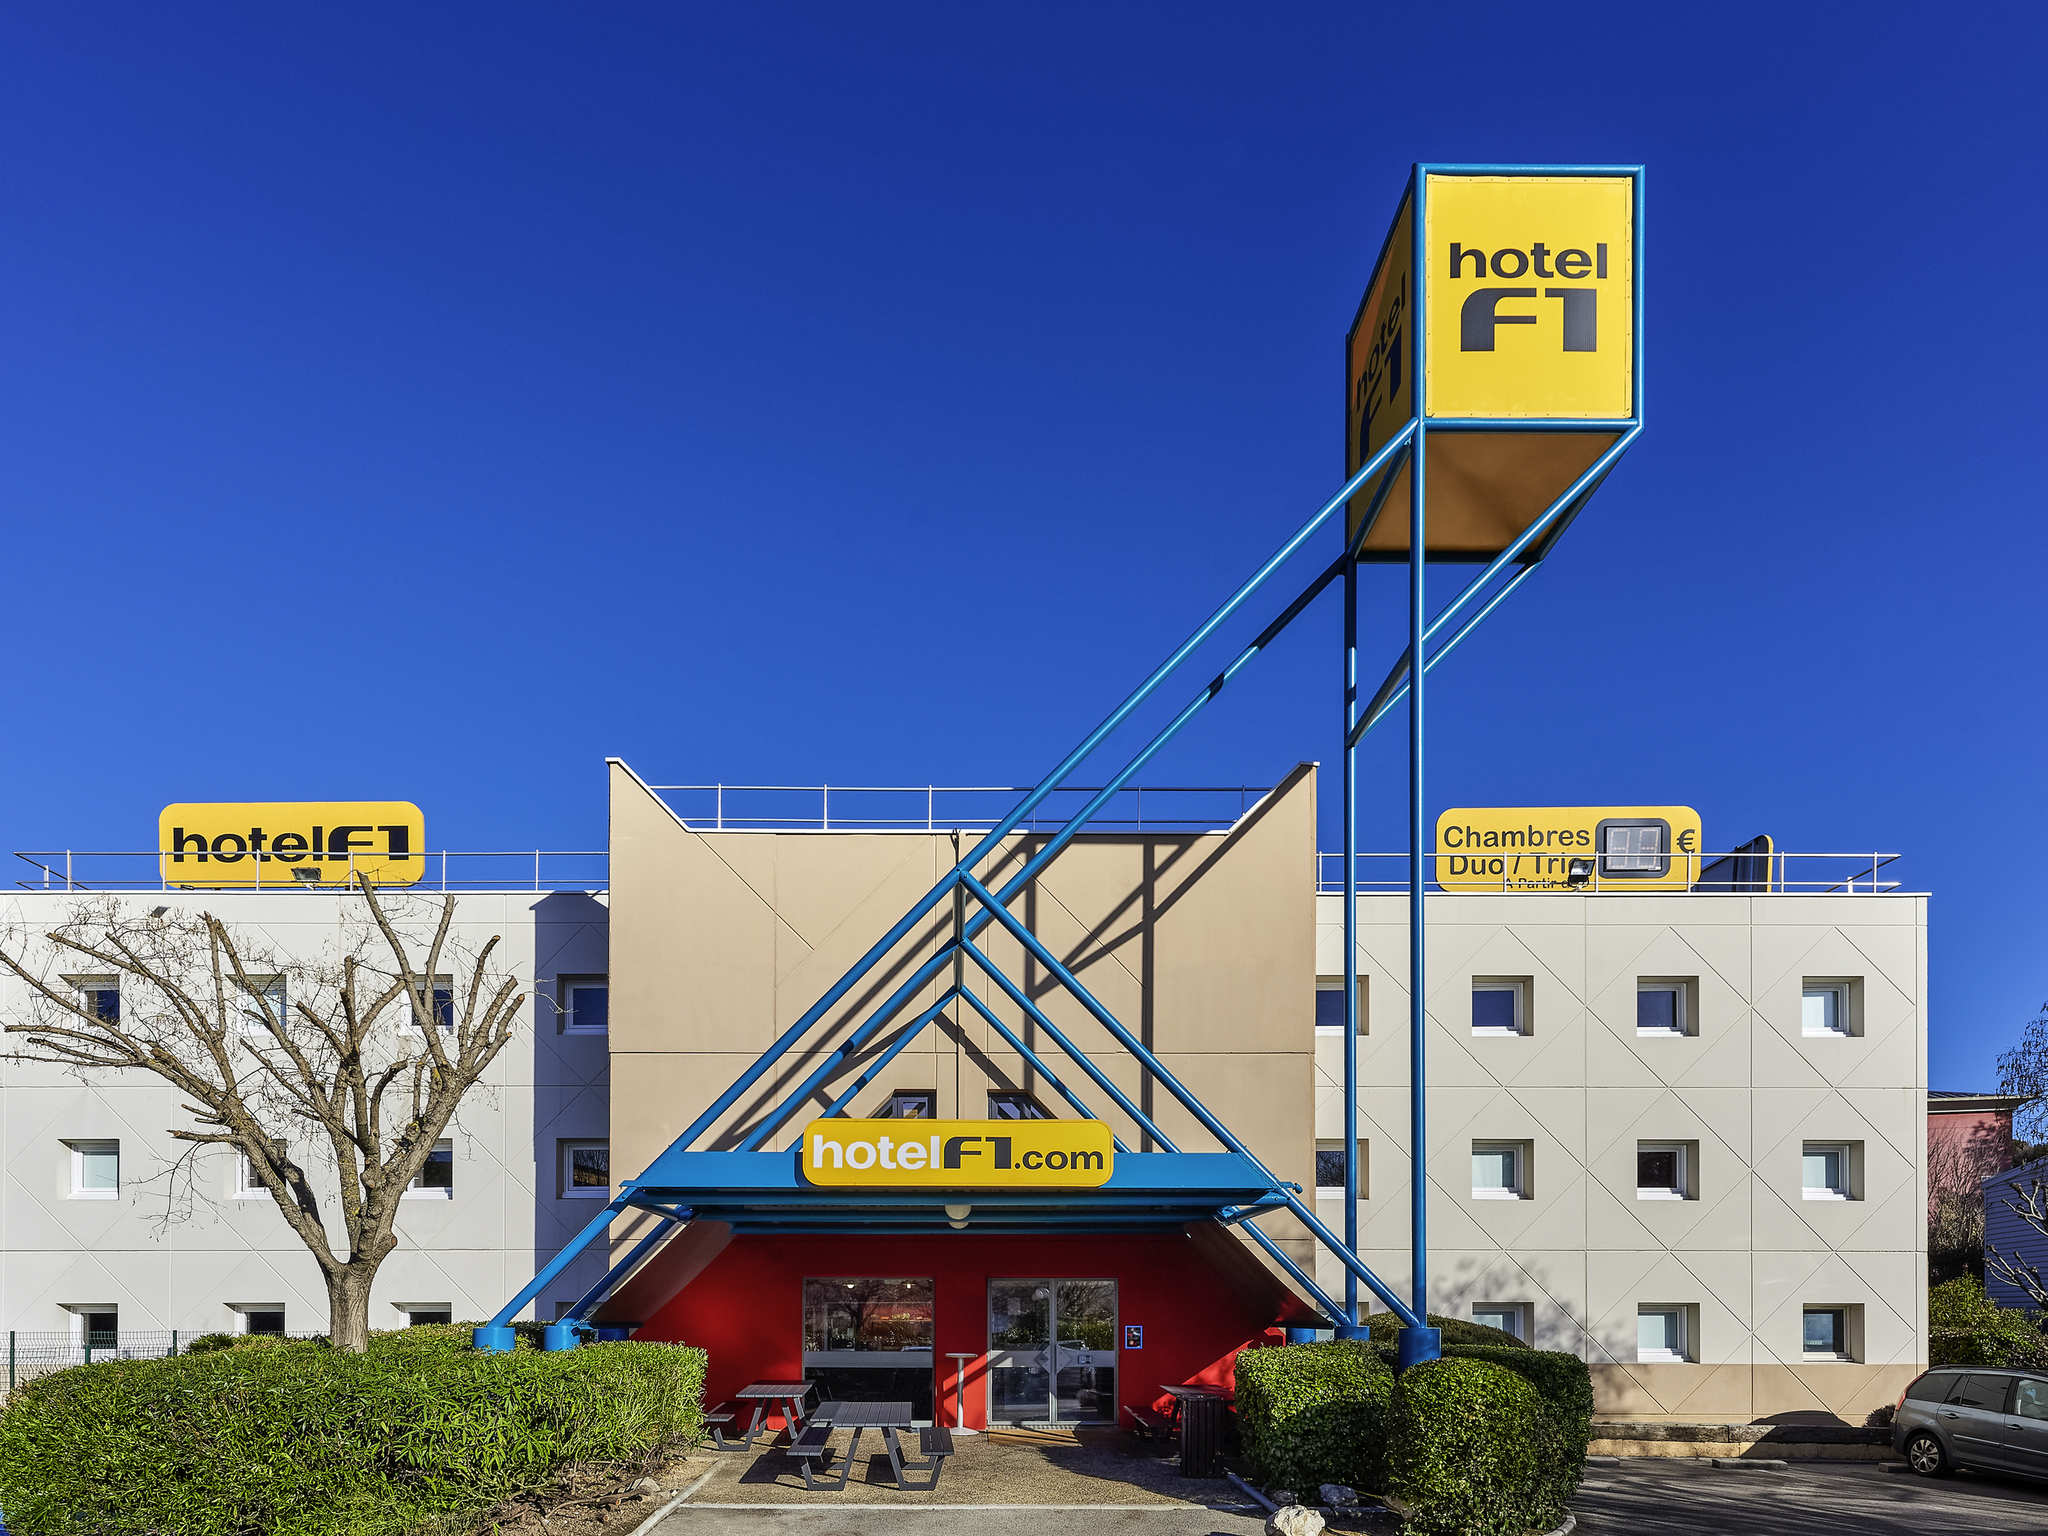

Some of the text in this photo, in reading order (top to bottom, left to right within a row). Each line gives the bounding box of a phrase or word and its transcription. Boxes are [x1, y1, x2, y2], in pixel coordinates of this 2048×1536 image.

[1450, 242, 1607, 279] hotel
[1460, 287, 1597, 352] F1
[1443, 825, 1590, 849] Chambres
[1676, 828, 1695, 854] €
[1449, 852, 1504, 875] Duo
[1529, 852, 1578, 875] Tri
